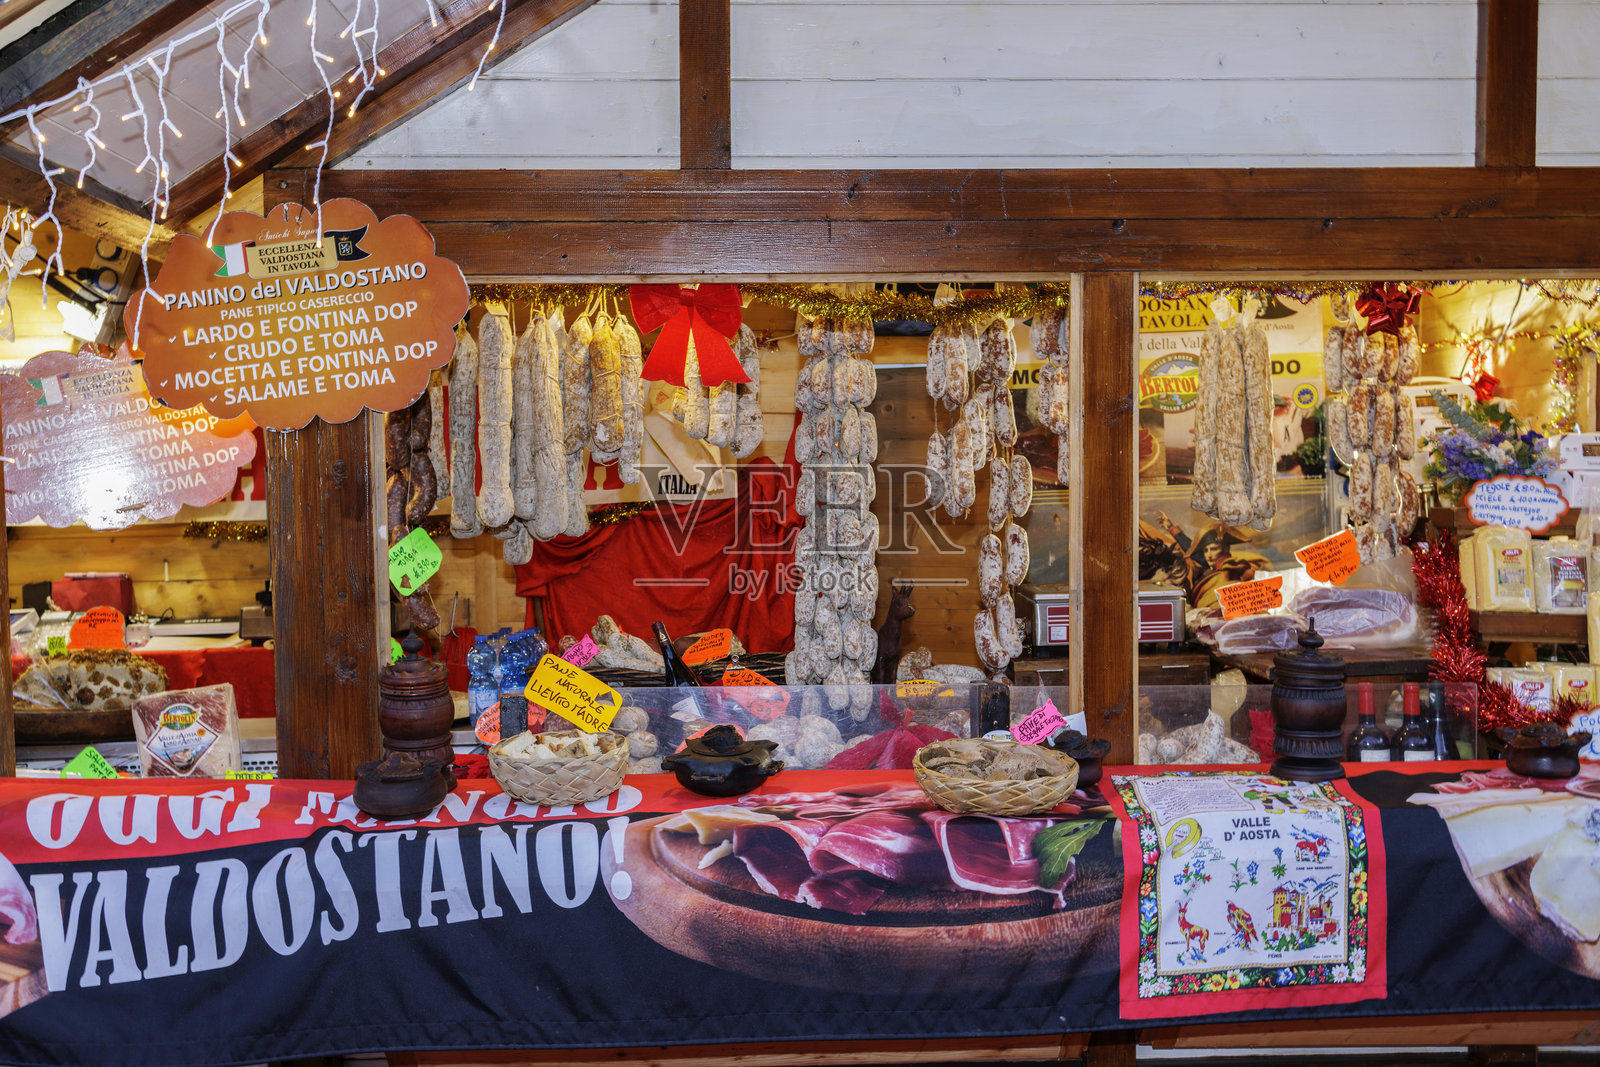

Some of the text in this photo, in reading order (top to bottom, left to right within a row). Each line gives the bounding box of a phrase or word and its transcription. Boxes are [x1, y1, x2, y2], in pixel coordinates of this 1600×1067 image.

[260, 251, 325, 265] VALDOSTANA
[268, 261, 320, 274] IN TAVOLA
[164, 262, 427, 311] PANINO del VALDOSTANO
[220, 291, 374, 320] PANE TIPICO CASERECCIO
[184, 301, 418, 346] LARDO E FONTINA DOP
[1264, 323, 1294, 331] d'Aosta
[224, 326, 384, 362] CRUDO E TOMA
[1147, 338, 1177, 350] della
[174, 340, 438, 390] MOCETTA E FONTINA DOP
[73, 369, 132, 386] ECCELLENZA
[224, 368, 396, 406] SALAME E TOMA
[96, 386, 130, 398] TAVOLA
[2, 416, 65, 440] ANINO
[182, 416, 219, 436] DOP
[138, 439, 192, 462] TOMA
[203, 446, 240, 467] DOP
[153, 472, 208, 496] TOMA
[543, 658, 578, 678] PANE
[530, 680, 570, 709] LIEVITO
[571, 704, 608, 732] MADRE
[556, 678, 605, 714] NATURALE
[1232, 816, 1271, 828] VALLE
[1224, 830, 1280, 842] D' AOSTA
[29, 816, 633, 993] VALDOSTANO!
